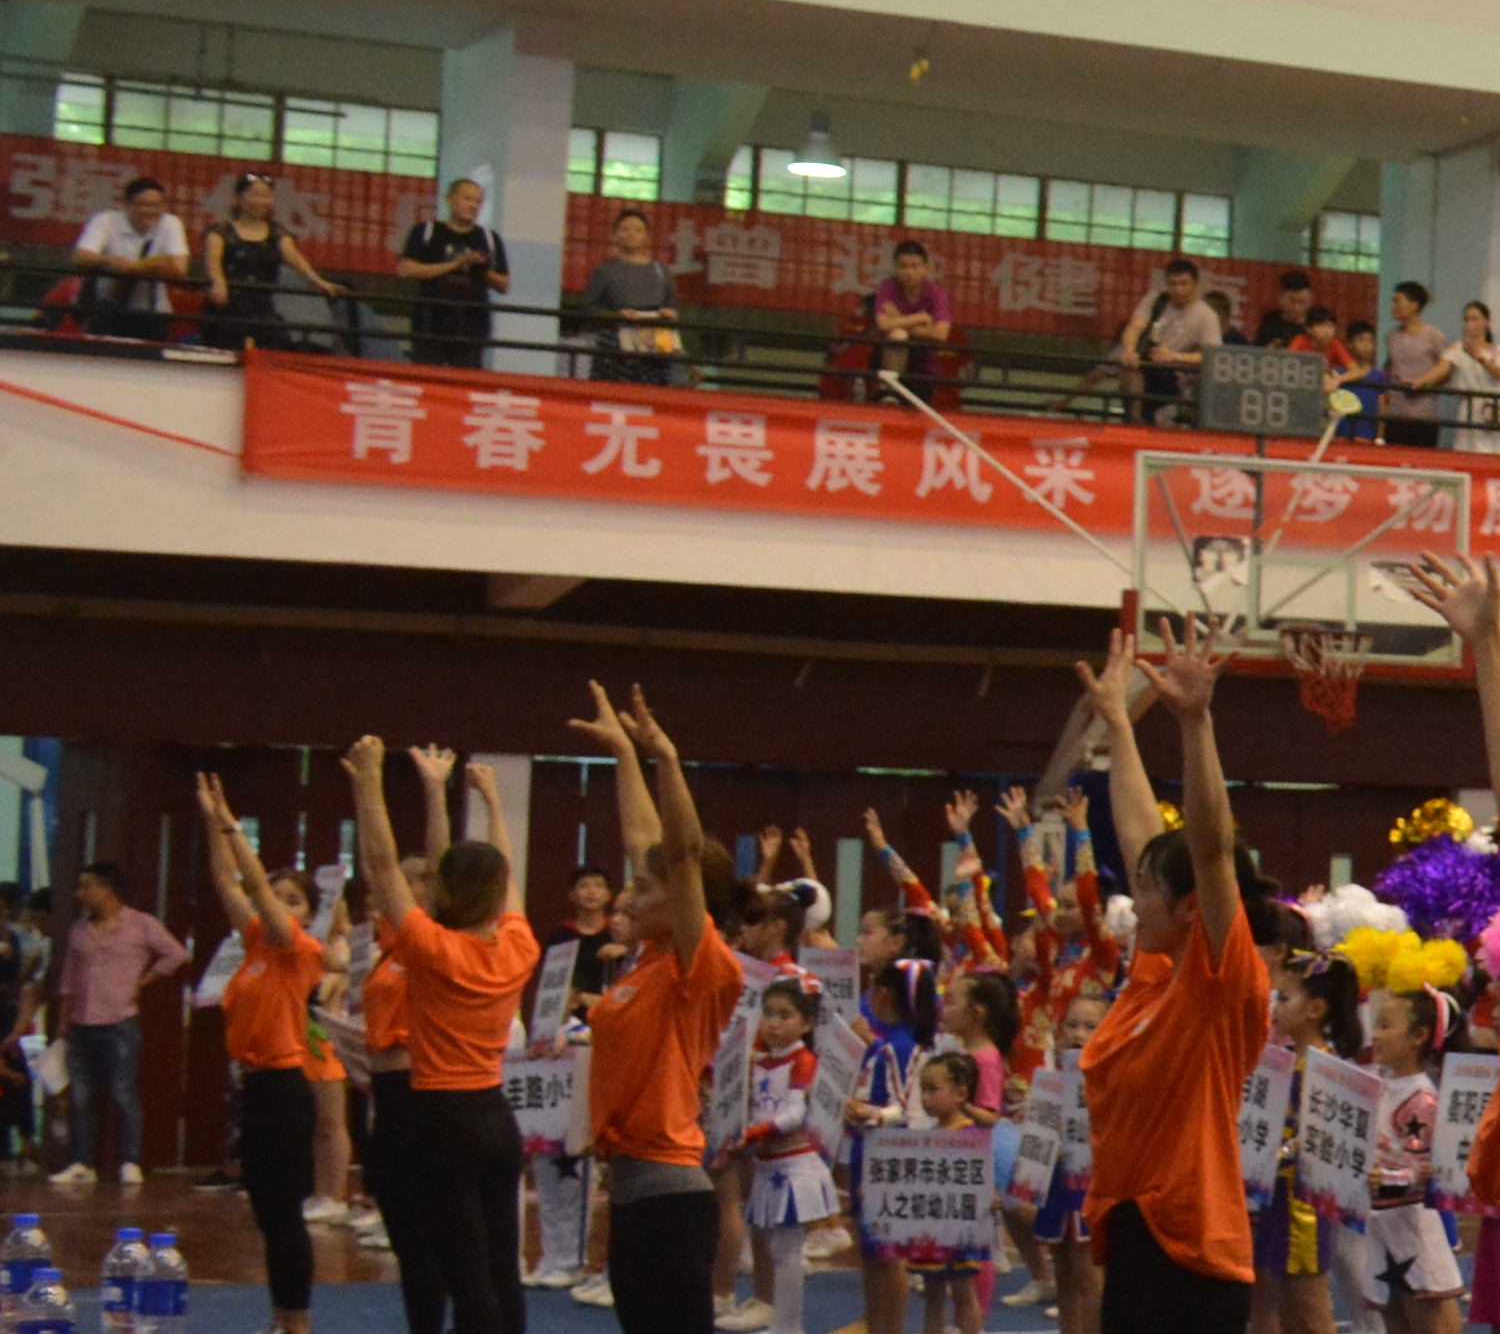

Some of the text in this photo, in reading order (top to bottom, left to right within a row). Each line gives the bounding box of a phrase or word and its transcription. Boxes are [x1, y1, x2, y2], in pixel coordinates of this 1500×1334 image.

[341, 379, 1096, 509] 青春无畏展风采
[869, 1157, 985, 1186] 张家界市永定区
[878, 1192, 977, 1222] 人之初幼儿园
